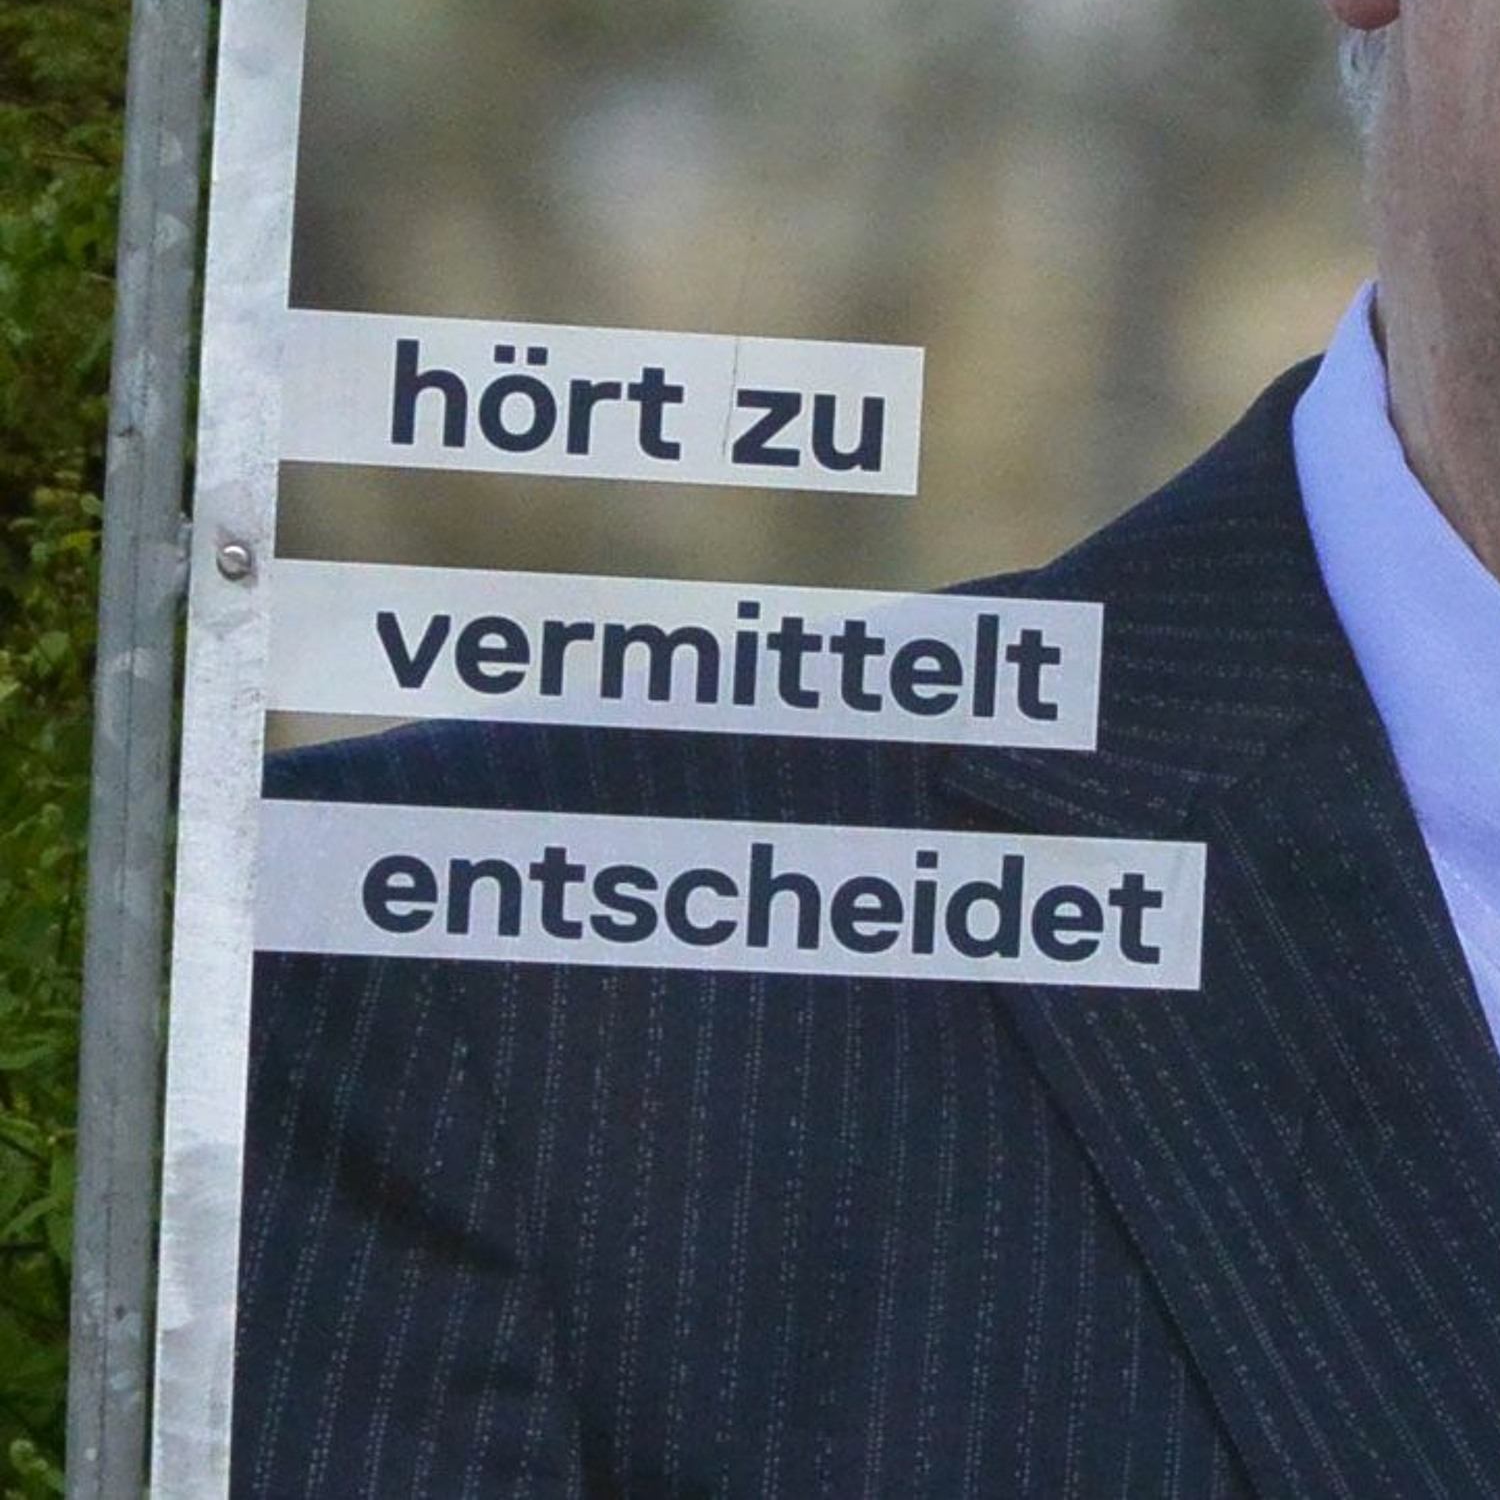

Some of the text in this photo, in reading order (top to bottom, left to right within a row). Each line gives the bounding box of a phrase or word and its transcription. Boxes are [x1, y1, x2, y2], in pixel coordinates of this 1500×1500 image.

[391, 339, 885, 472] hört zu
[376, 600, 1061, 722] vermittelt
[362, 842, 1163, 965] entscheidet
